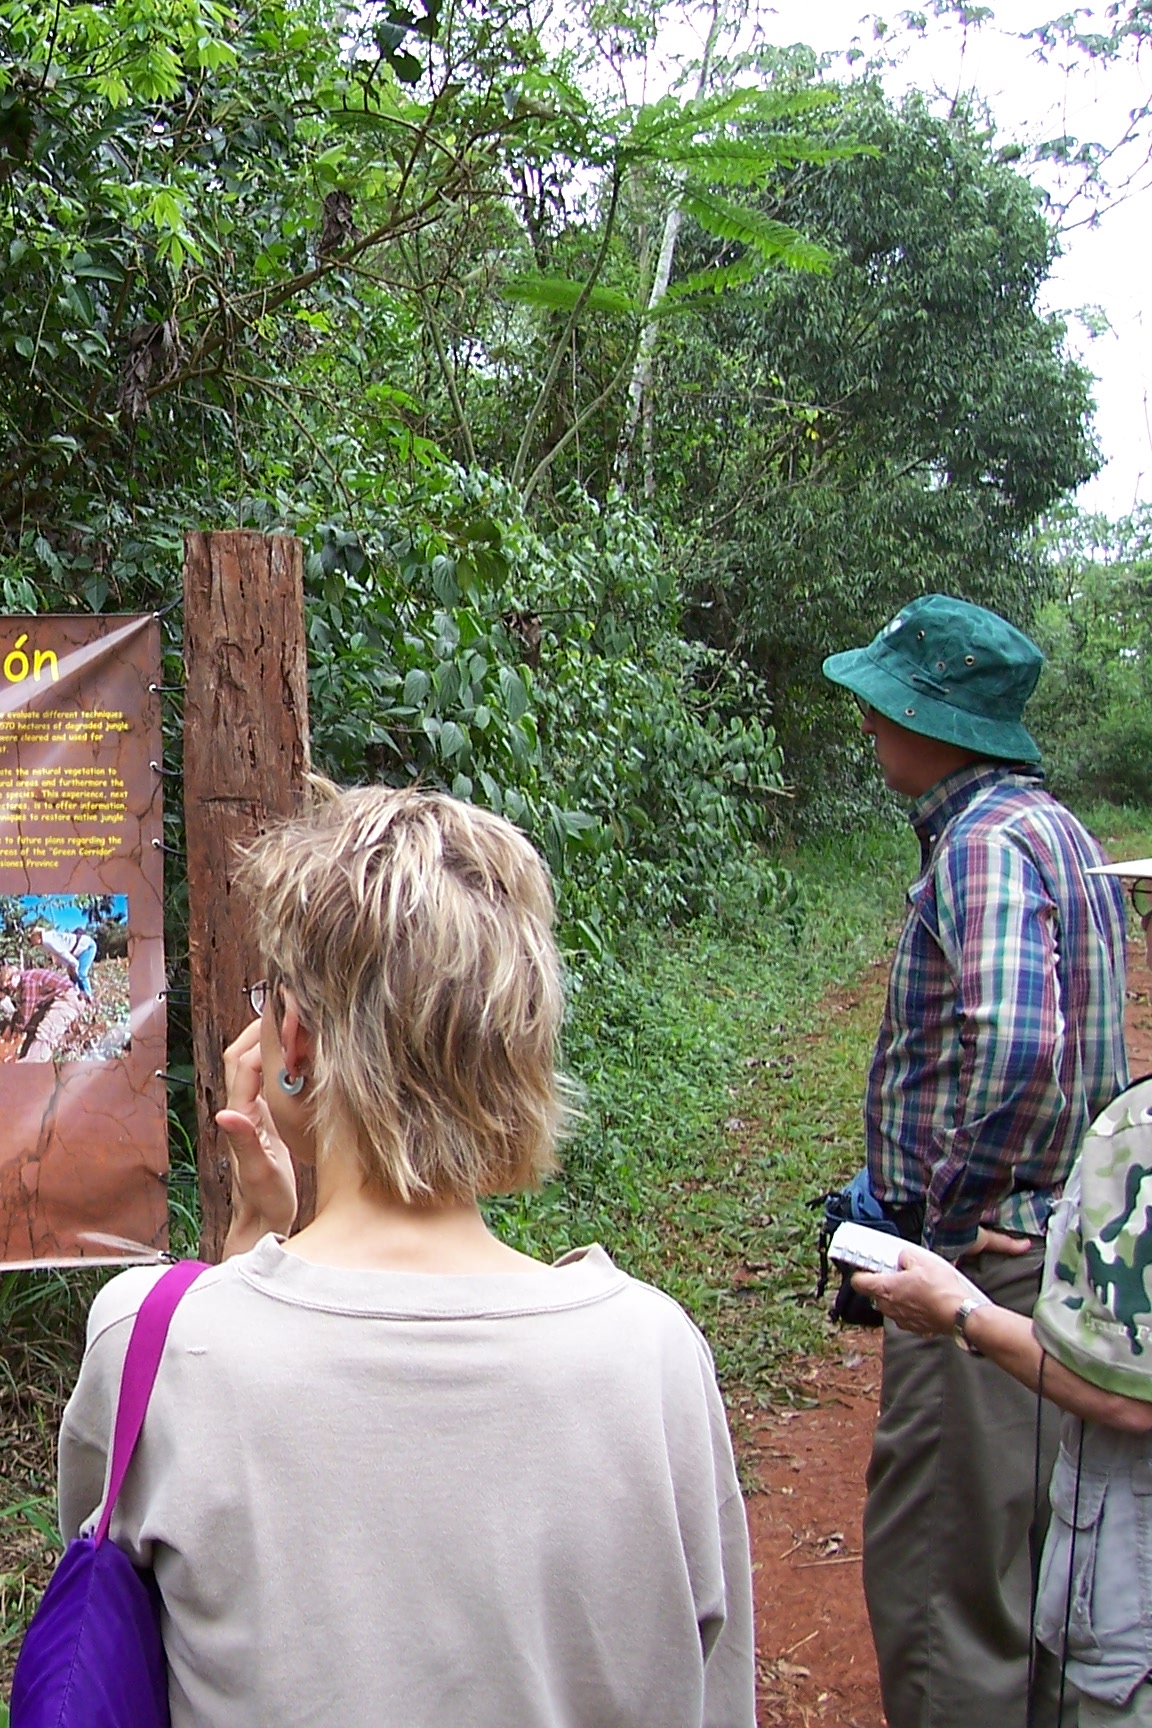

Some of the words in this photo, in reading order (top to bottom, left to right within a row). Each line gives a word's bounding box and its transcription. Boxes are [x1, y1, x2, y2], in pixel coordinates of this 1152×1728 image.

[7, 710, 40, 719] evaluate
[43, 710, 77, 719] different
[81, 709, 123, 720] techniques
[17, 721, 50, 730] hectares
[53, 721, 62, 730] of
[65, 721, 103, 731] degraded
[105, 721, 128, 732] jungle
[21, 733, 49, 742] cleared
[52, 733, 66, 741] and
[69, 733, 88, 741] used
[91, 732, 104, 741] for
[16, 767, 29, 776] the
[32, 766, 62, 775] natural
[64, 767, 105, 777] vegetation
[16, 779, 39, 787] areas
[41, 778, 56, 787] and
[59, 777, 108, 787] furthermore
[111, 778, 124, 787] the
[6, 789, 37, 800] species.
[41, 789, 59, 798] This
[61, 790, 107, 800] experience,
[110, 790, 128, 798] next
[44, 801, 53, 810] to
[55, 800, 77, 810] offer
[80, 801, 128, 811] information,
[30, 813, 39, 821] to
[41, 813, 70, 821] restore
[74, 813, 98, 821] native
[101, 813, 126, 823] jungle.
[5, 836, 14, 845] to
[17, 836, 42, 845] future
[45, 836, 65, 846] plans
[68, 836, 106, 846] regarding
[108, 836, 122, 844] the
[20, 847, 29, 856] of
[33, 847, 46, 856] the
[26, 859, 59, 868] Province
